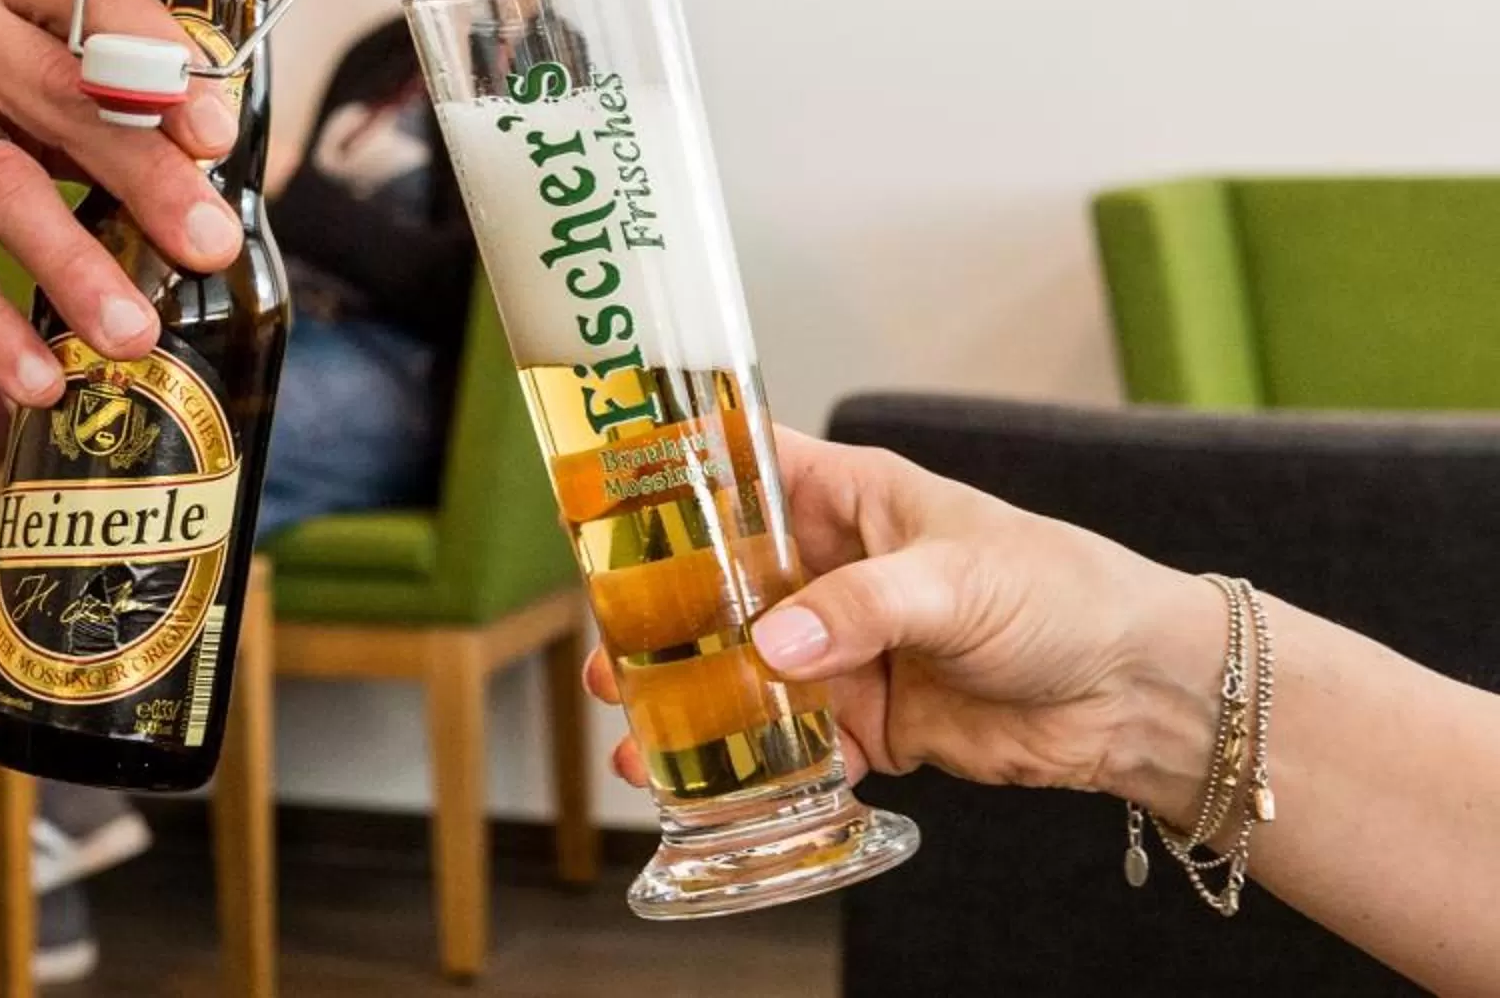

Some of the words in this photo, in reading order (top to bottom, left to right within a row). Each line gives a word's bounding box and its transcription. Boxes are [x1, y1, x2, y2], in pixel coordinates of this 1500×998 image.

[497, 61, 663, 435] Fischer's
[594, 71, 665, 250] Frisches
[600, 431, 720, 475] Brauhau
